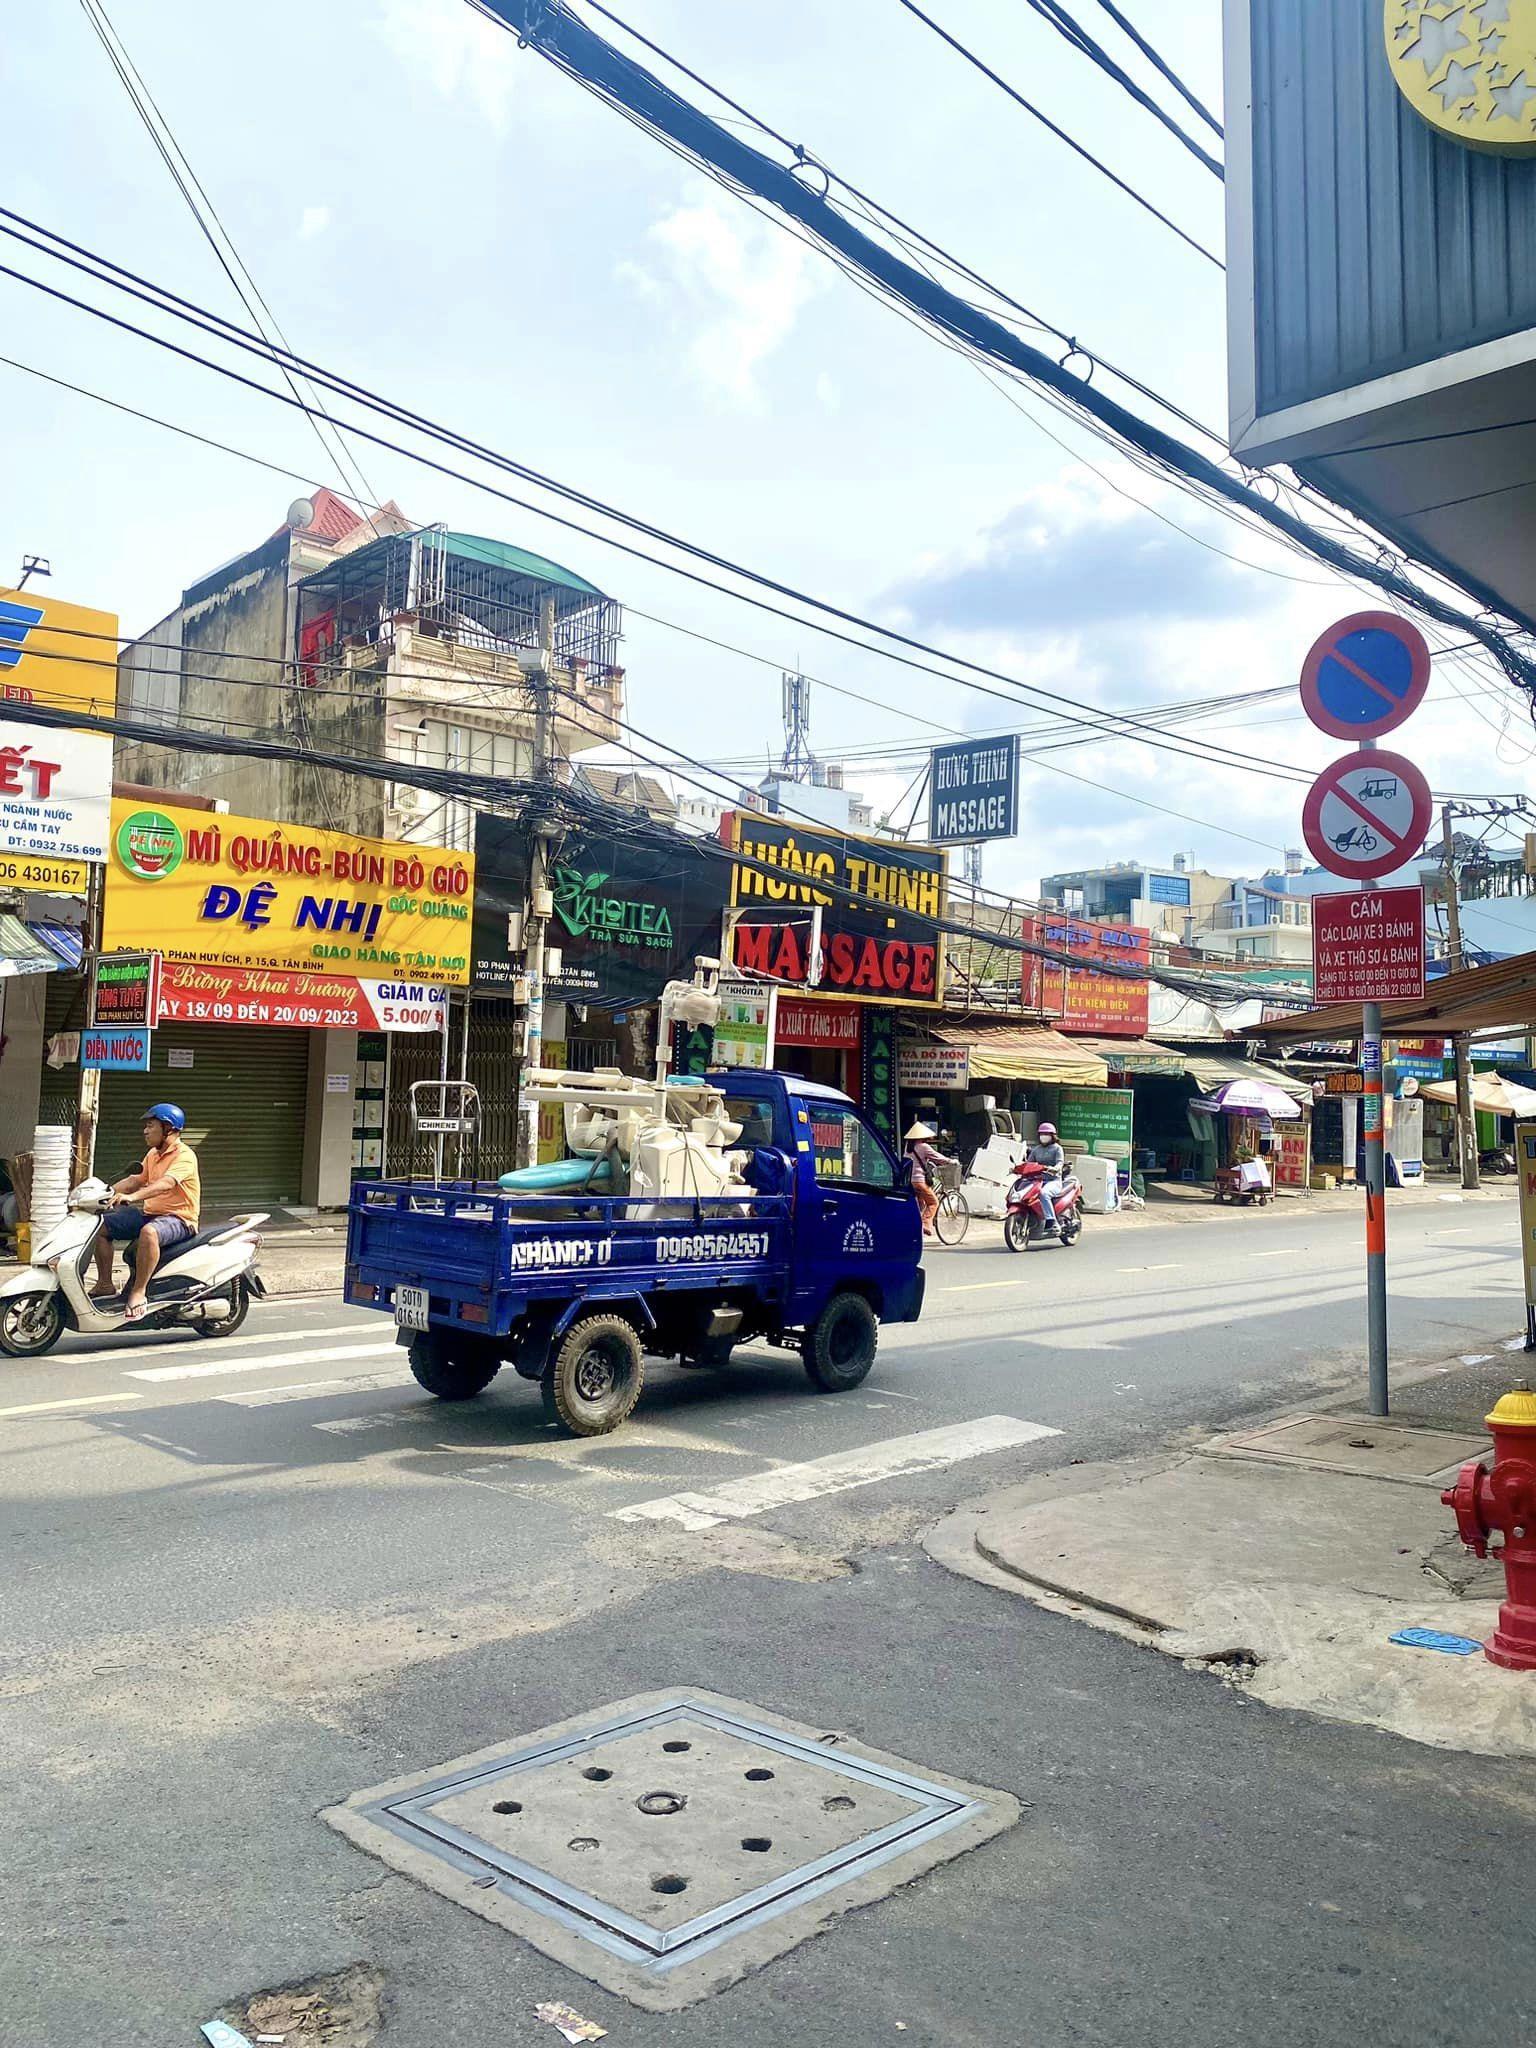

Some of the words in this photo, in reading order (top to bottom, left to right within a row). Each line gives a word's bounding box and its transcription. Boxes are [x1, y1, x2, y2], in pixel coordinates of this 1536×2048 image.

[937, 752, 969, 790] HƯNG
[972, 747, 1009, 789] THỊNH
[937, 795, 1006, 837] MASSAGE
[41, 824, 61, 835] TAY
[29, 839, 56, 851] 0932
[60, 843, 79, 854] 755
[82, 846, 102, 856] 699
[188, 825, 221, 863] MÌ
[393, 854, 424, 890] BÒ
[431, 861, 469, 896] GIÒ
[22, 866, 80, 885] 430167
[742, 838, 835, 906] HƯNG
[846, 857, 938, 928] THỊNH
[203, 881, 278, 930] ĐỆ
[296, 895, 383, 942] NHỊ
[1351, 893, 1383, 919] CẤM
[1321, 923, 1339, 942] CÁC
[1340, 925, 1361, 944] LOẠI
[1364, 924, 1376, 940] XE
[1378, 924, 1384, 939] 3
[1386, 918, 1414, 938] BÁNH
[169, 950, 196, 960] PHAN
[200, 953, 219, 961] HUY
[283, 958, 301, 968] TÂN
[302, 958, 324, 970] BÌNH
[313, 944, 350, 960] GIAO
[1320, 947, 1332, 967] VÀ
[1334, 951, 1345, 966] XE
[1347, 946, 1365, 965] THÔ
[1382, 949, 1389, 963] 4
[1391, 943, 1418, 963] BÁNH
[409, 970, 428, 980] 0902
[431, 972, 445, 981] 499
[447, 973, 460, 982] 197
[477, 960, 489, 969] 130
[491, 962, 510, 971] PHAN
[1375, 965, 1388, 980] ĐẾN
[1390, 968, 1397, 979] 13
[1410, 967, 1418, 978] 00
[173, 964, 233, 1000] Bừng
[238, 970, 290, 994] Khai
[294, 973, 358, 1006] Trương
[378, 979, 423, 1001] GIẢM
[1376, 981, 1389, 996] ĐẾN
[1391, 984, 1398, 995] 22
[1412, 983, 1420, 994] 00
[186, 1001, 233, 1019] 18/09
[238, 999, 269, 1020] ĐẾN
[274, 1006, 358, 1025] 20/09/2023
[786, 1008, 806, 1036] XUẤT
[838, 1009, 859, 1038] XUẤT
[86, 1033, 107, 1061] ĐIỆN
[111, 1033, 143, 1061] NƯỚC
[871, 1016, 891, 1177] MASSAE
[656, 1232, 769, 1262] 0968564551
[398, 1307, 425, 1328] 016.11
